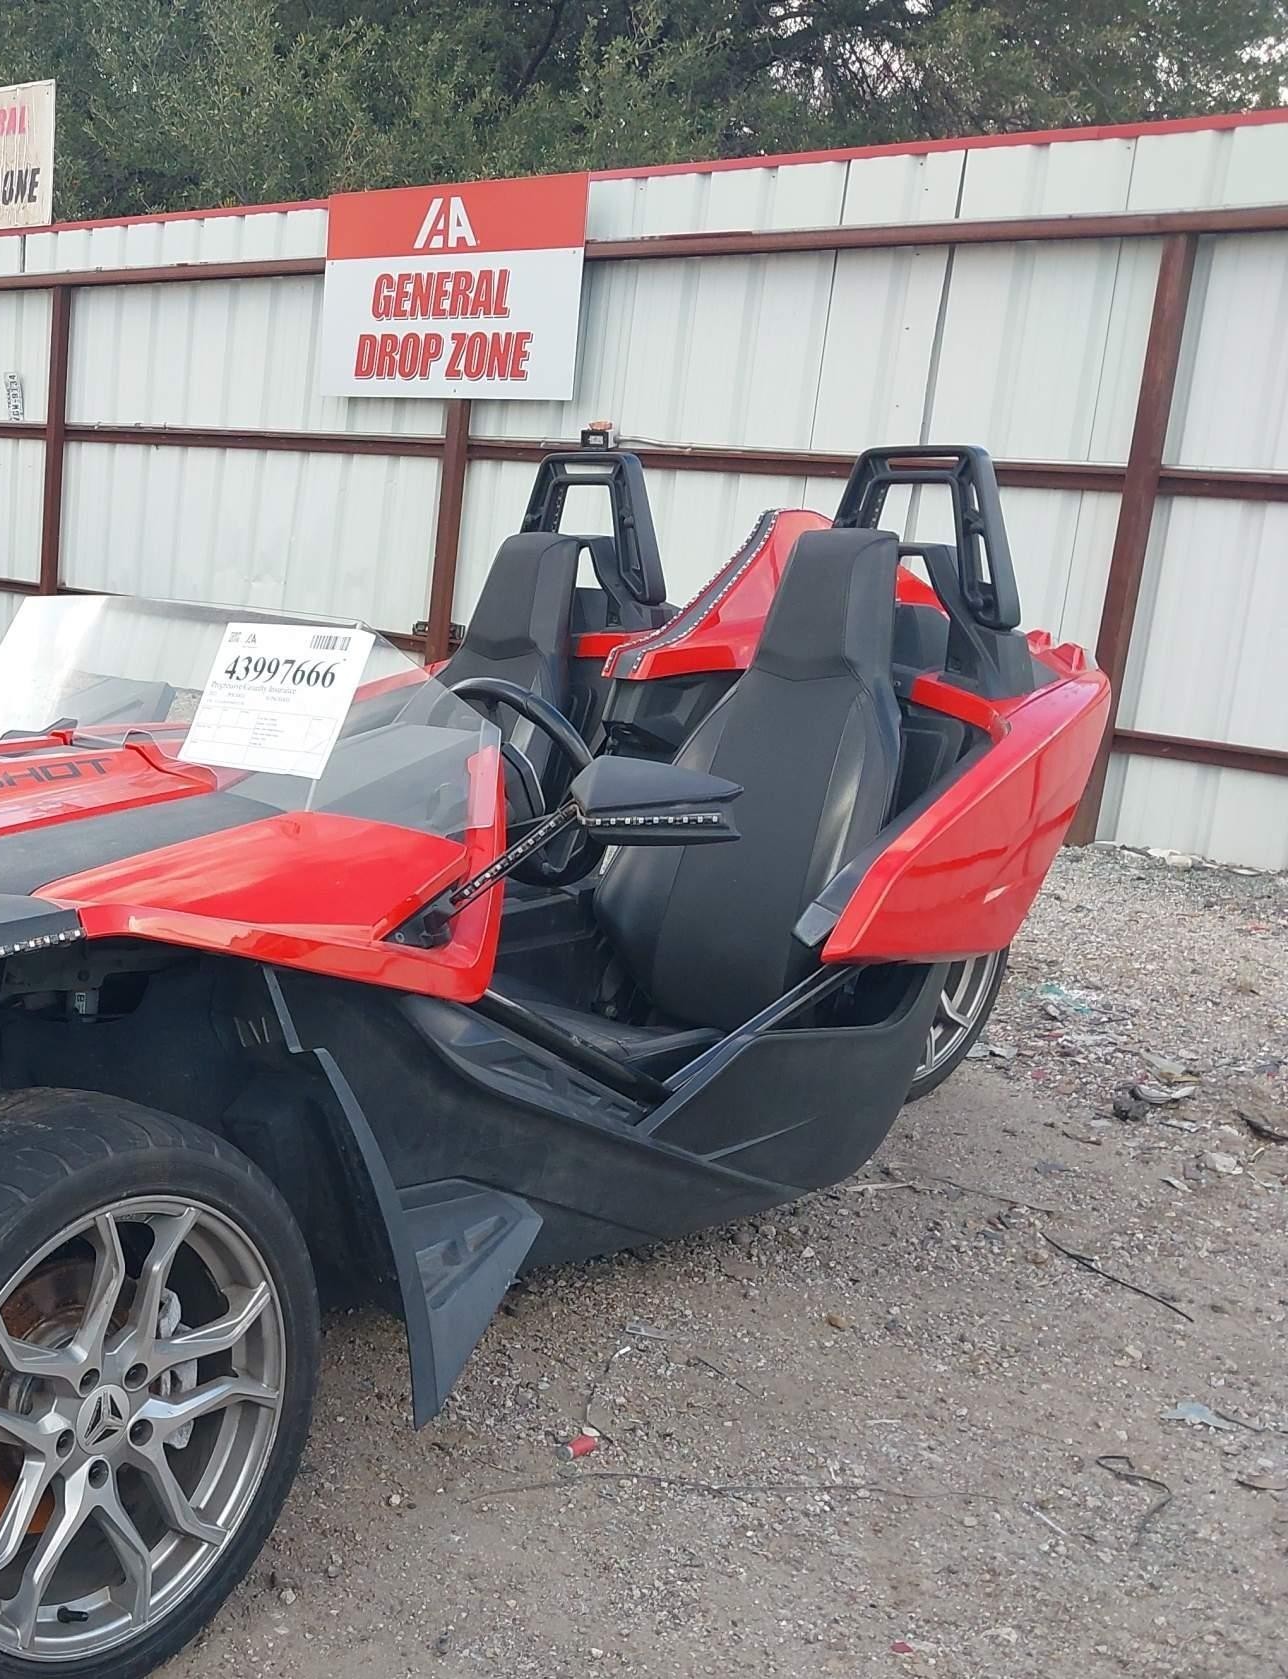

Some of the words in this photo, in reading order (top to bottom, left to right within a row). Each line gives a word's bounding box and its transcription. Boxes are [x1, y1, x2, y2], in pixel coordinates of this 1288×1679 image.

[371, 268, 511, 321] GENERAL
[354, 332, 444, 380] DROP
[444, 331, 533, 381] ZONE
[224, 655, 340, 688] 43997666
